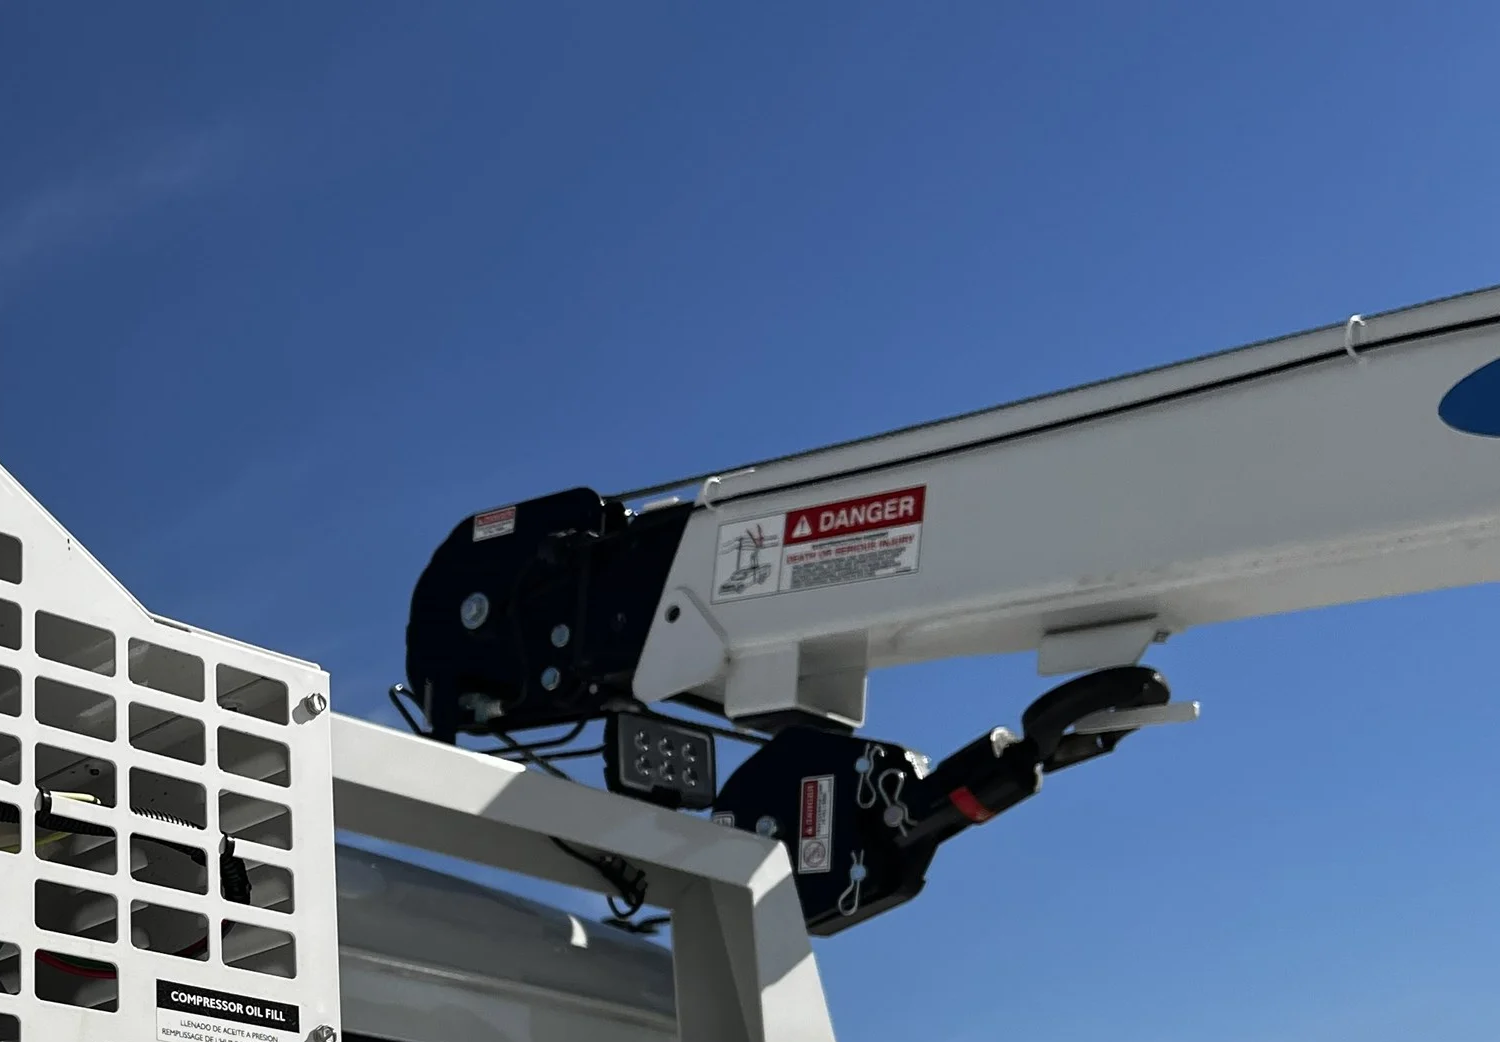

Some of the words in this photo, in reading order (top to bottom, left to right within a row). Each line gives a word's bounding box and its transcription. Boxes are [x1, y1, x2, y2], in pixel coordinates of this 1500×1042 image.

[818, 495, 915, 533] DANGER
[170, 991, 244, 1014] COMPRESSOR
[246, 1005, 263, 1018] OIL
[265, 1008, 286, 1022] FILL
[162, 1027, 203, 1042] REMPLISSAGE
[205, 1033, 214, 1042] DE
[180, 1019, 211, 1032] LLENADO
[212, 1024, 221, 1033] DE
[222, 1027, 245, 1038] ACEITE
